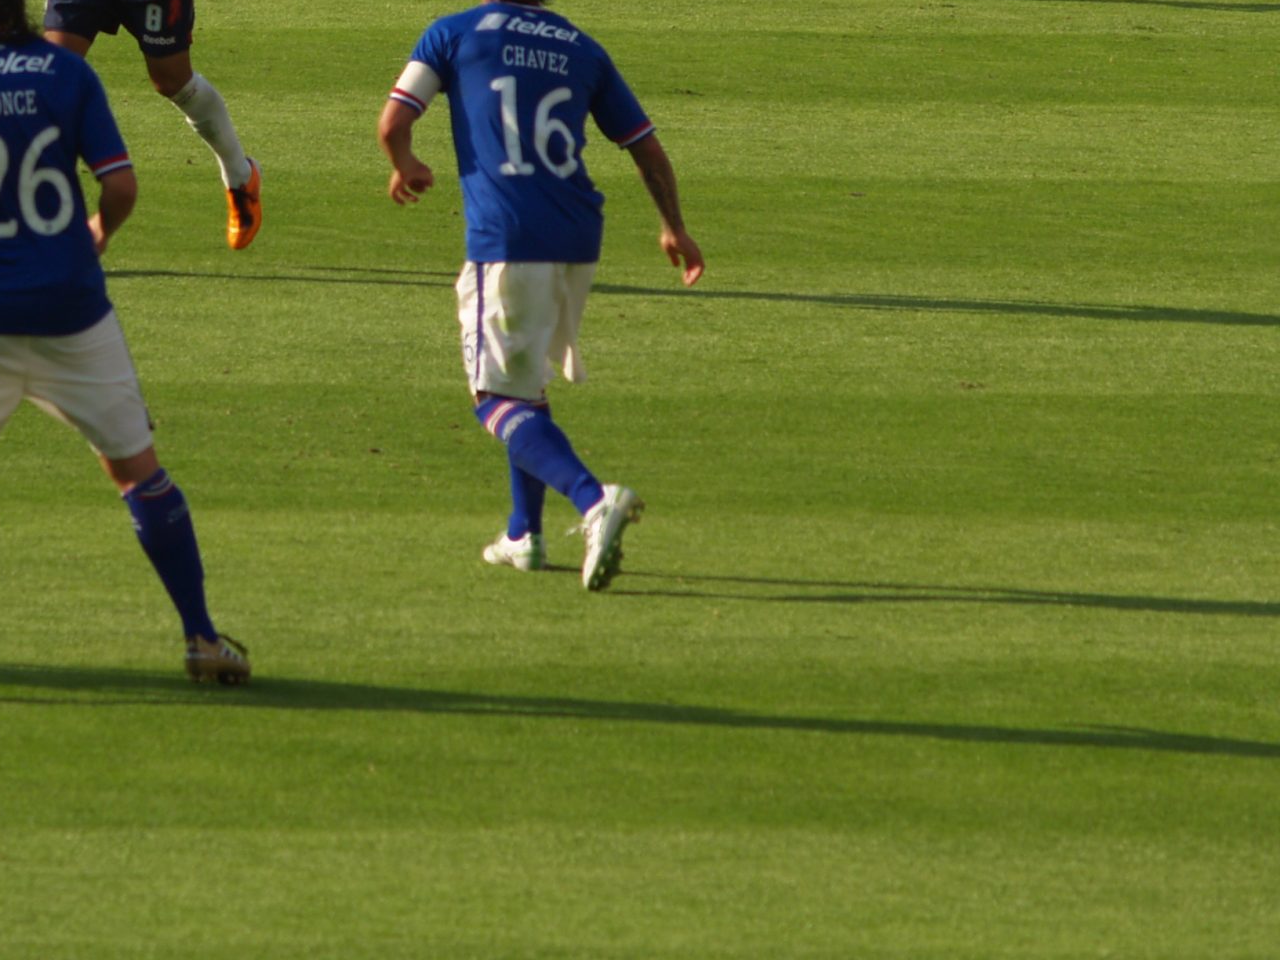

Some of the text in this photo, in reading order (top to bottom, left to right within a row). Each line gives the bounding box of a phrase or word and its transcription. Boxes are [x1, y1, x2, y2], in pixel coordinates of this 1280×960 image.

[145, 3, 162, 32] 8
[506, 15, 579, 44] telcel
[502, 45, 568, 75] CHAVEZ
[490, 75, 578, 179] 16
